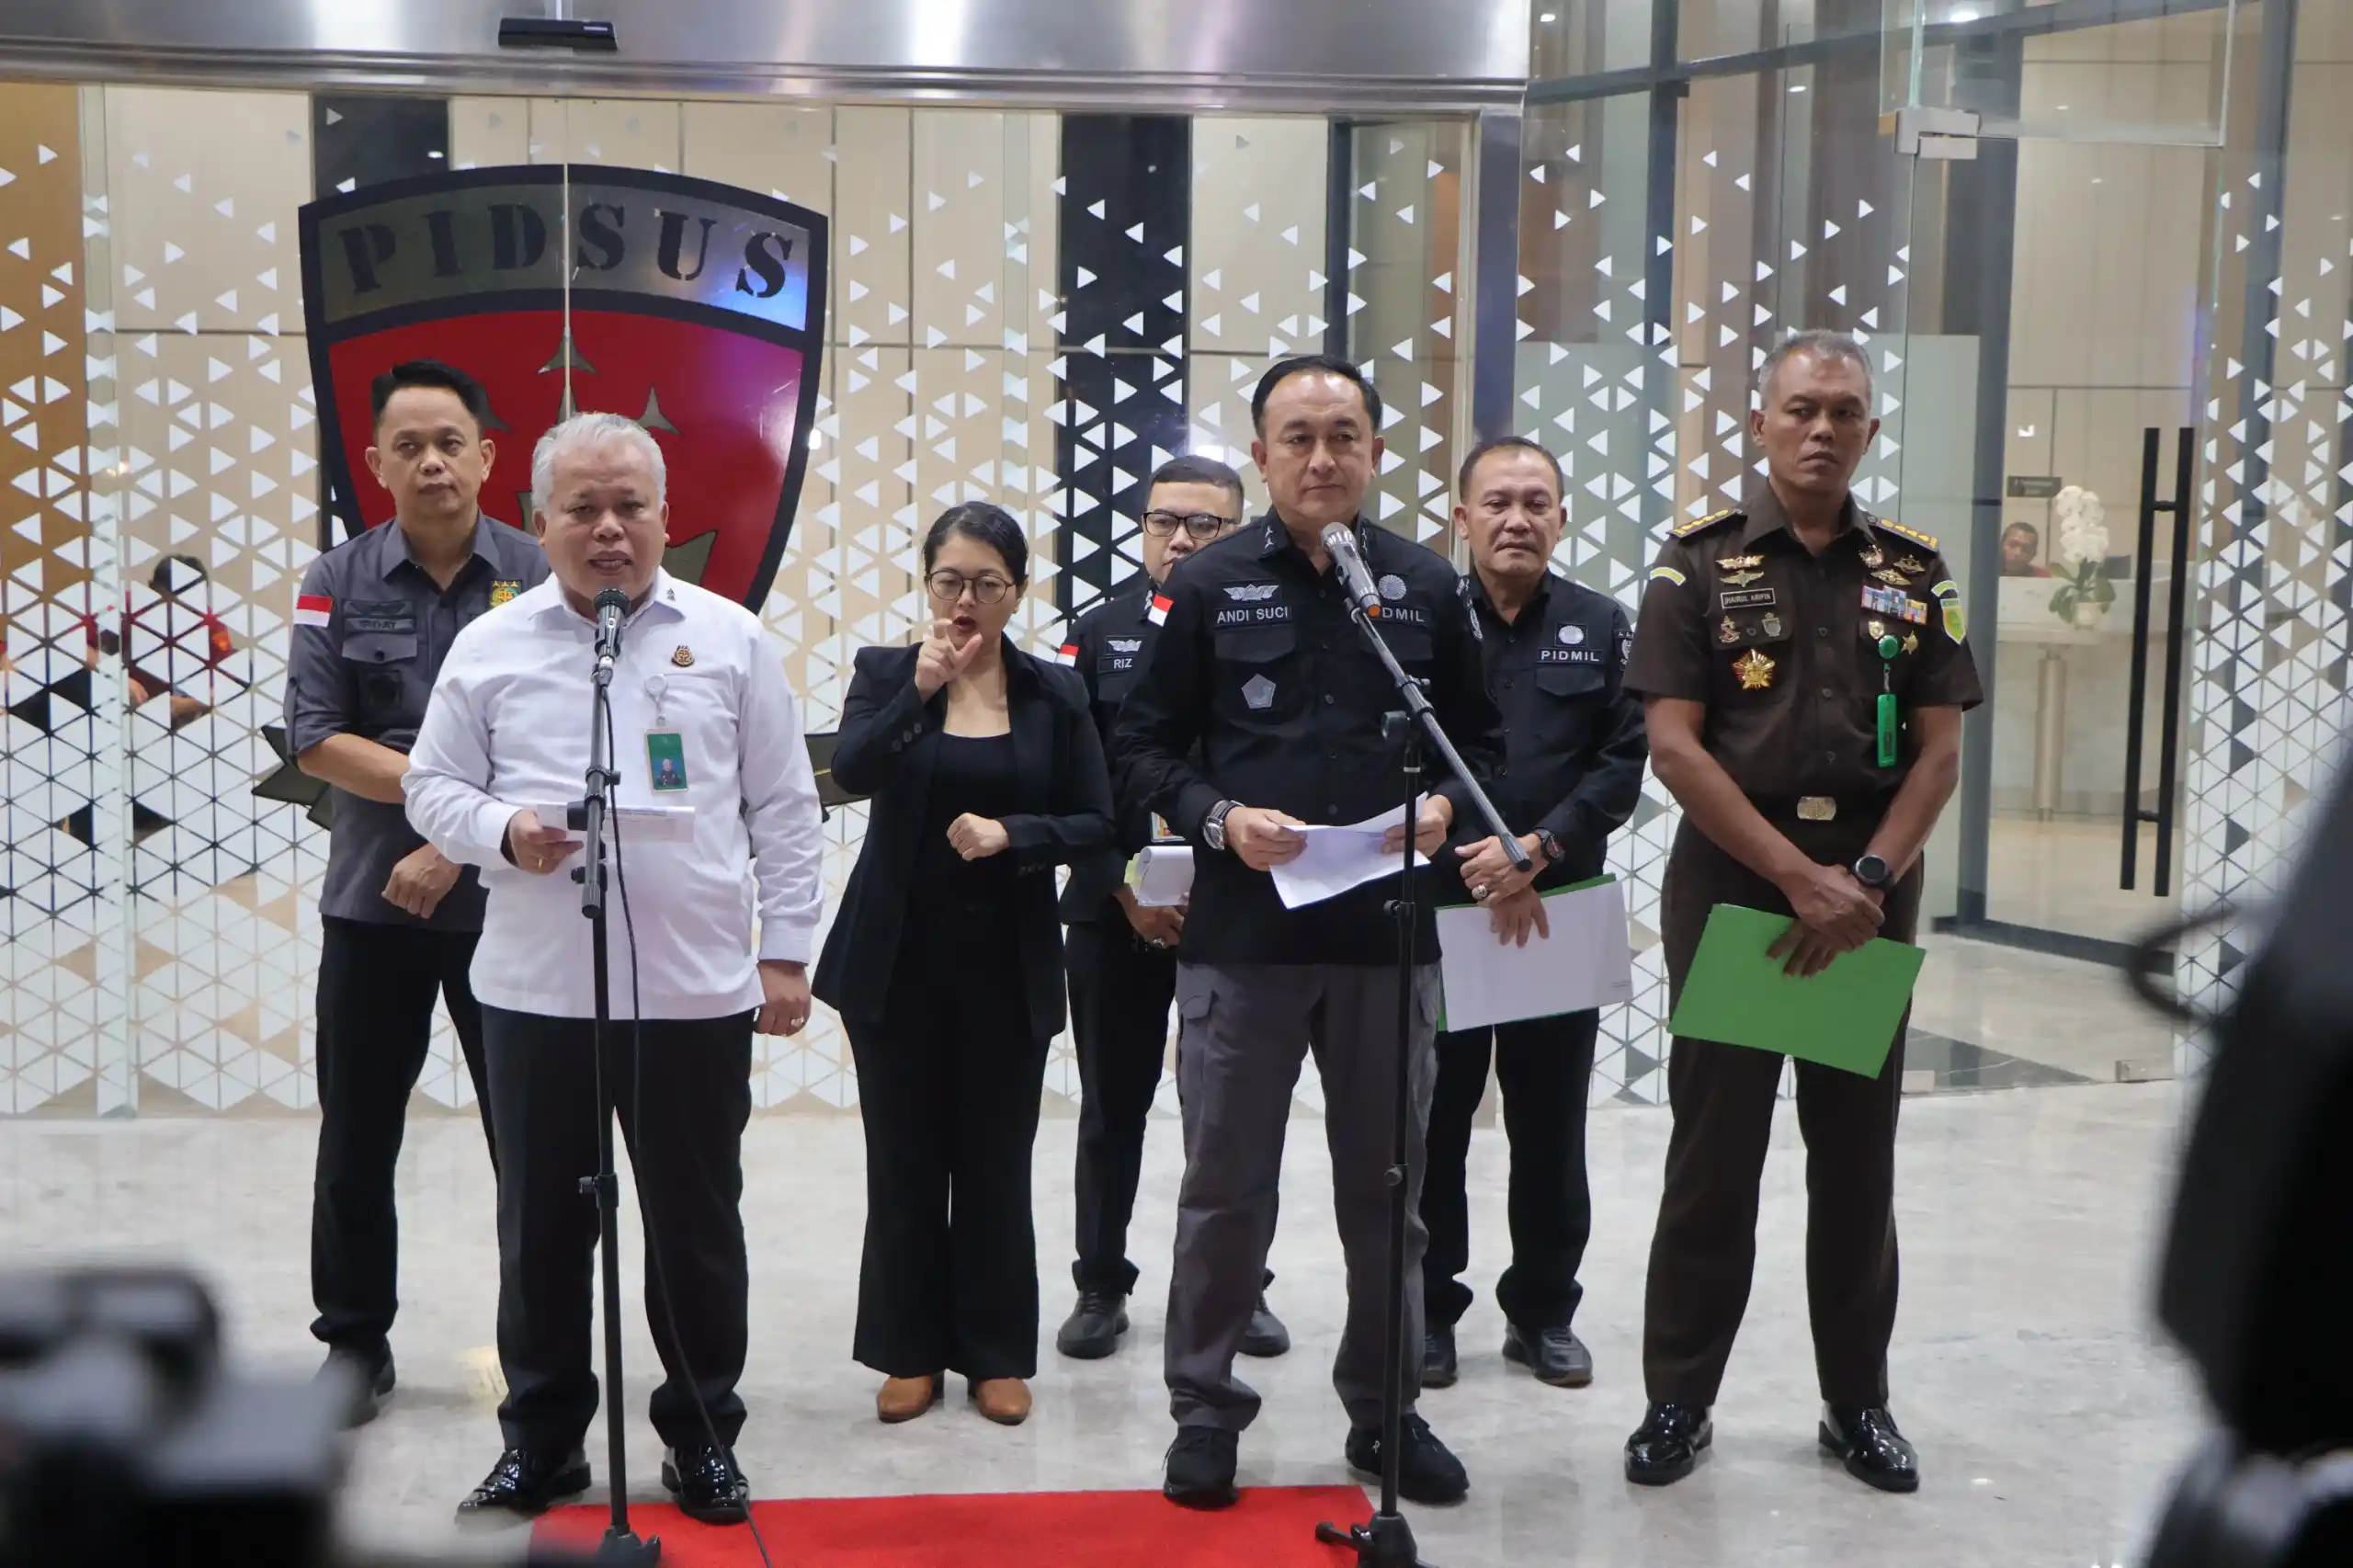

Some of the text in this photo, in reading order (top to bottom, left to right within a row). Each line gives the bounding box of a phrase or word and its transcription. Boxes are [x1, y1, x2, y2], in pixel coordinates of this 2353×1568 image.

[337, 202, 793, 299] PIDSUS
[1216, 606, 1289, 624] ANDI SUCI
[1381, 607, 1425, 623] DMIL
[1113, 658, 1133, 670] RIZ
[1540, 650, 1599, 662] PIDMIL
